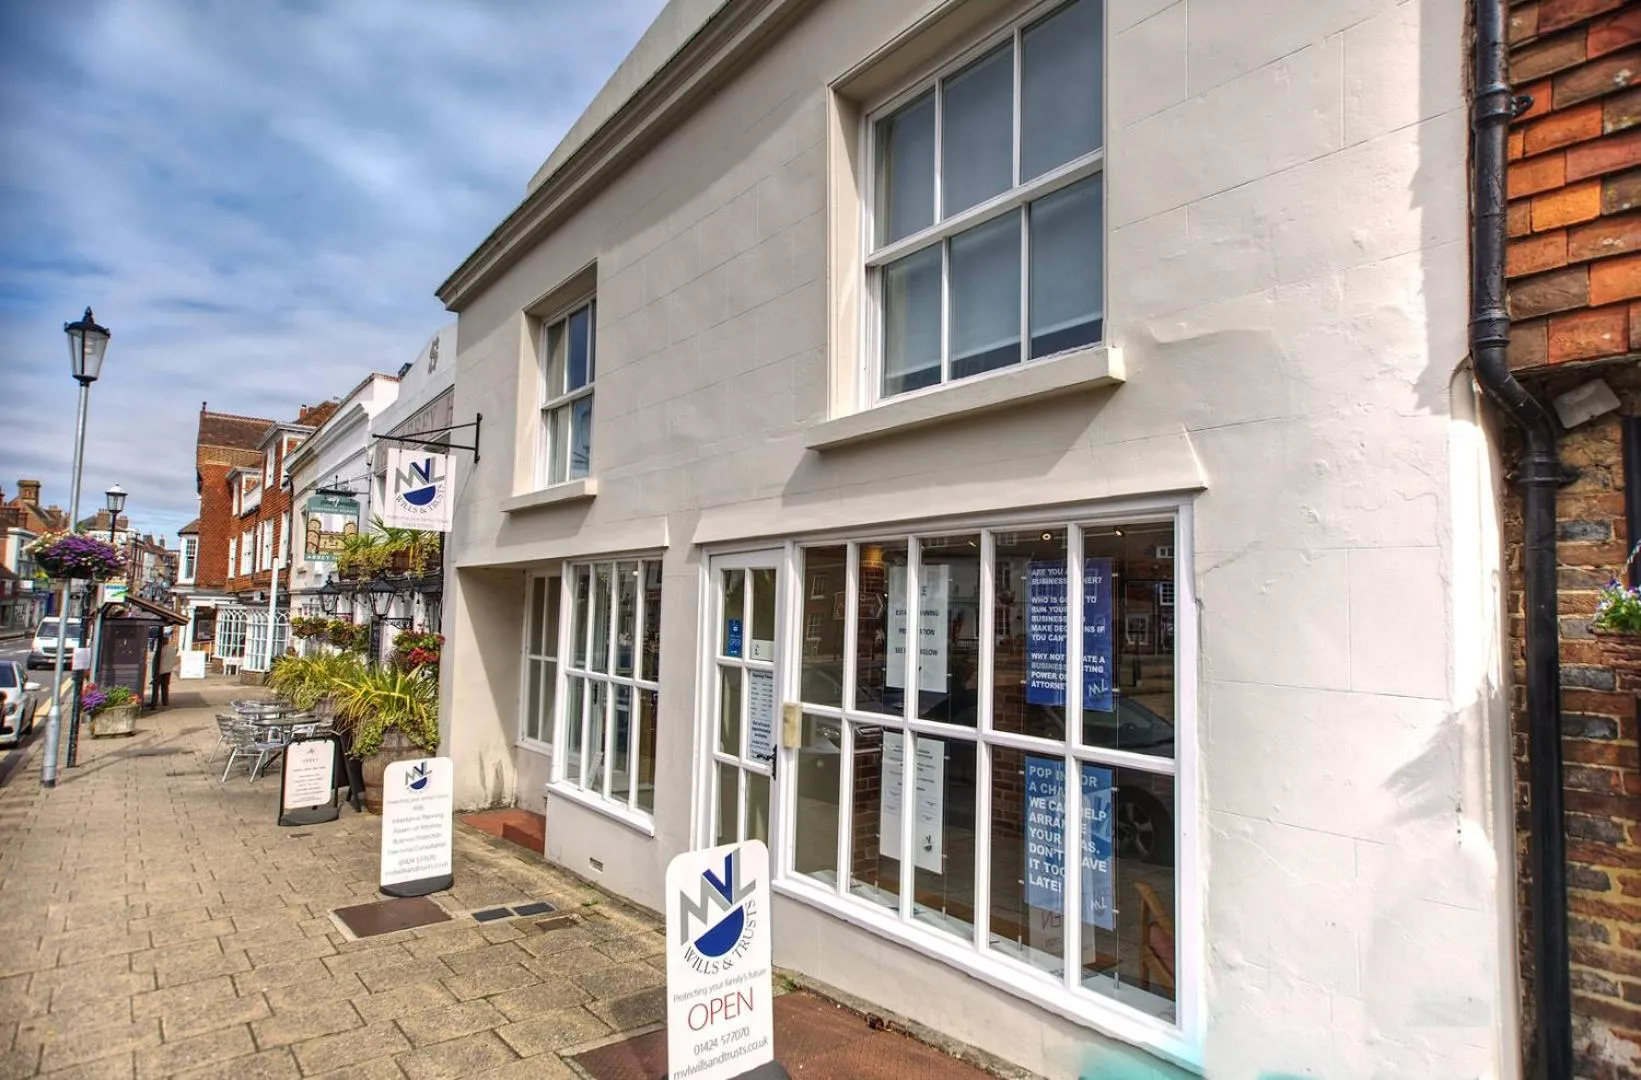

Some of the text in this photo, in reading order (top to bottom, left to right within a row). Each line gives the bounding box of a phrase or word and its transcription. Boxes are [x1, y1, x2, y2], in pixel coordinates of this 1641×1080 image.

[1032, 568, 1044, 576] ARE
[1031, 652, 1048, 661] WHY
[1049, 653, 1065, 662] NOT
[1099, 656, 1106, 664] A
[1031, 671, 1057, 680] POWER
[1029, 765, 1052, 779] POP
[1028, 781, 1037, 792] A
[1028, 796, 1046, 810] WE
[1084, 807, 1107, 821] ELP
[1028, 826, 1061, 844] YOUR
[1028, 842, 1107, 873] DON'T AVE
[1028, 858, 1040, 870] IT
[1028, 872, 1062, 893] LATE!
[684, 899, 757, 975] WILLS & TRUSTS
[673, 968, 768, 1004] Protecting your family's future
[687, 986, 754, 1032] OPEN
[693, 1026, 750, 1056] 01424 577070
